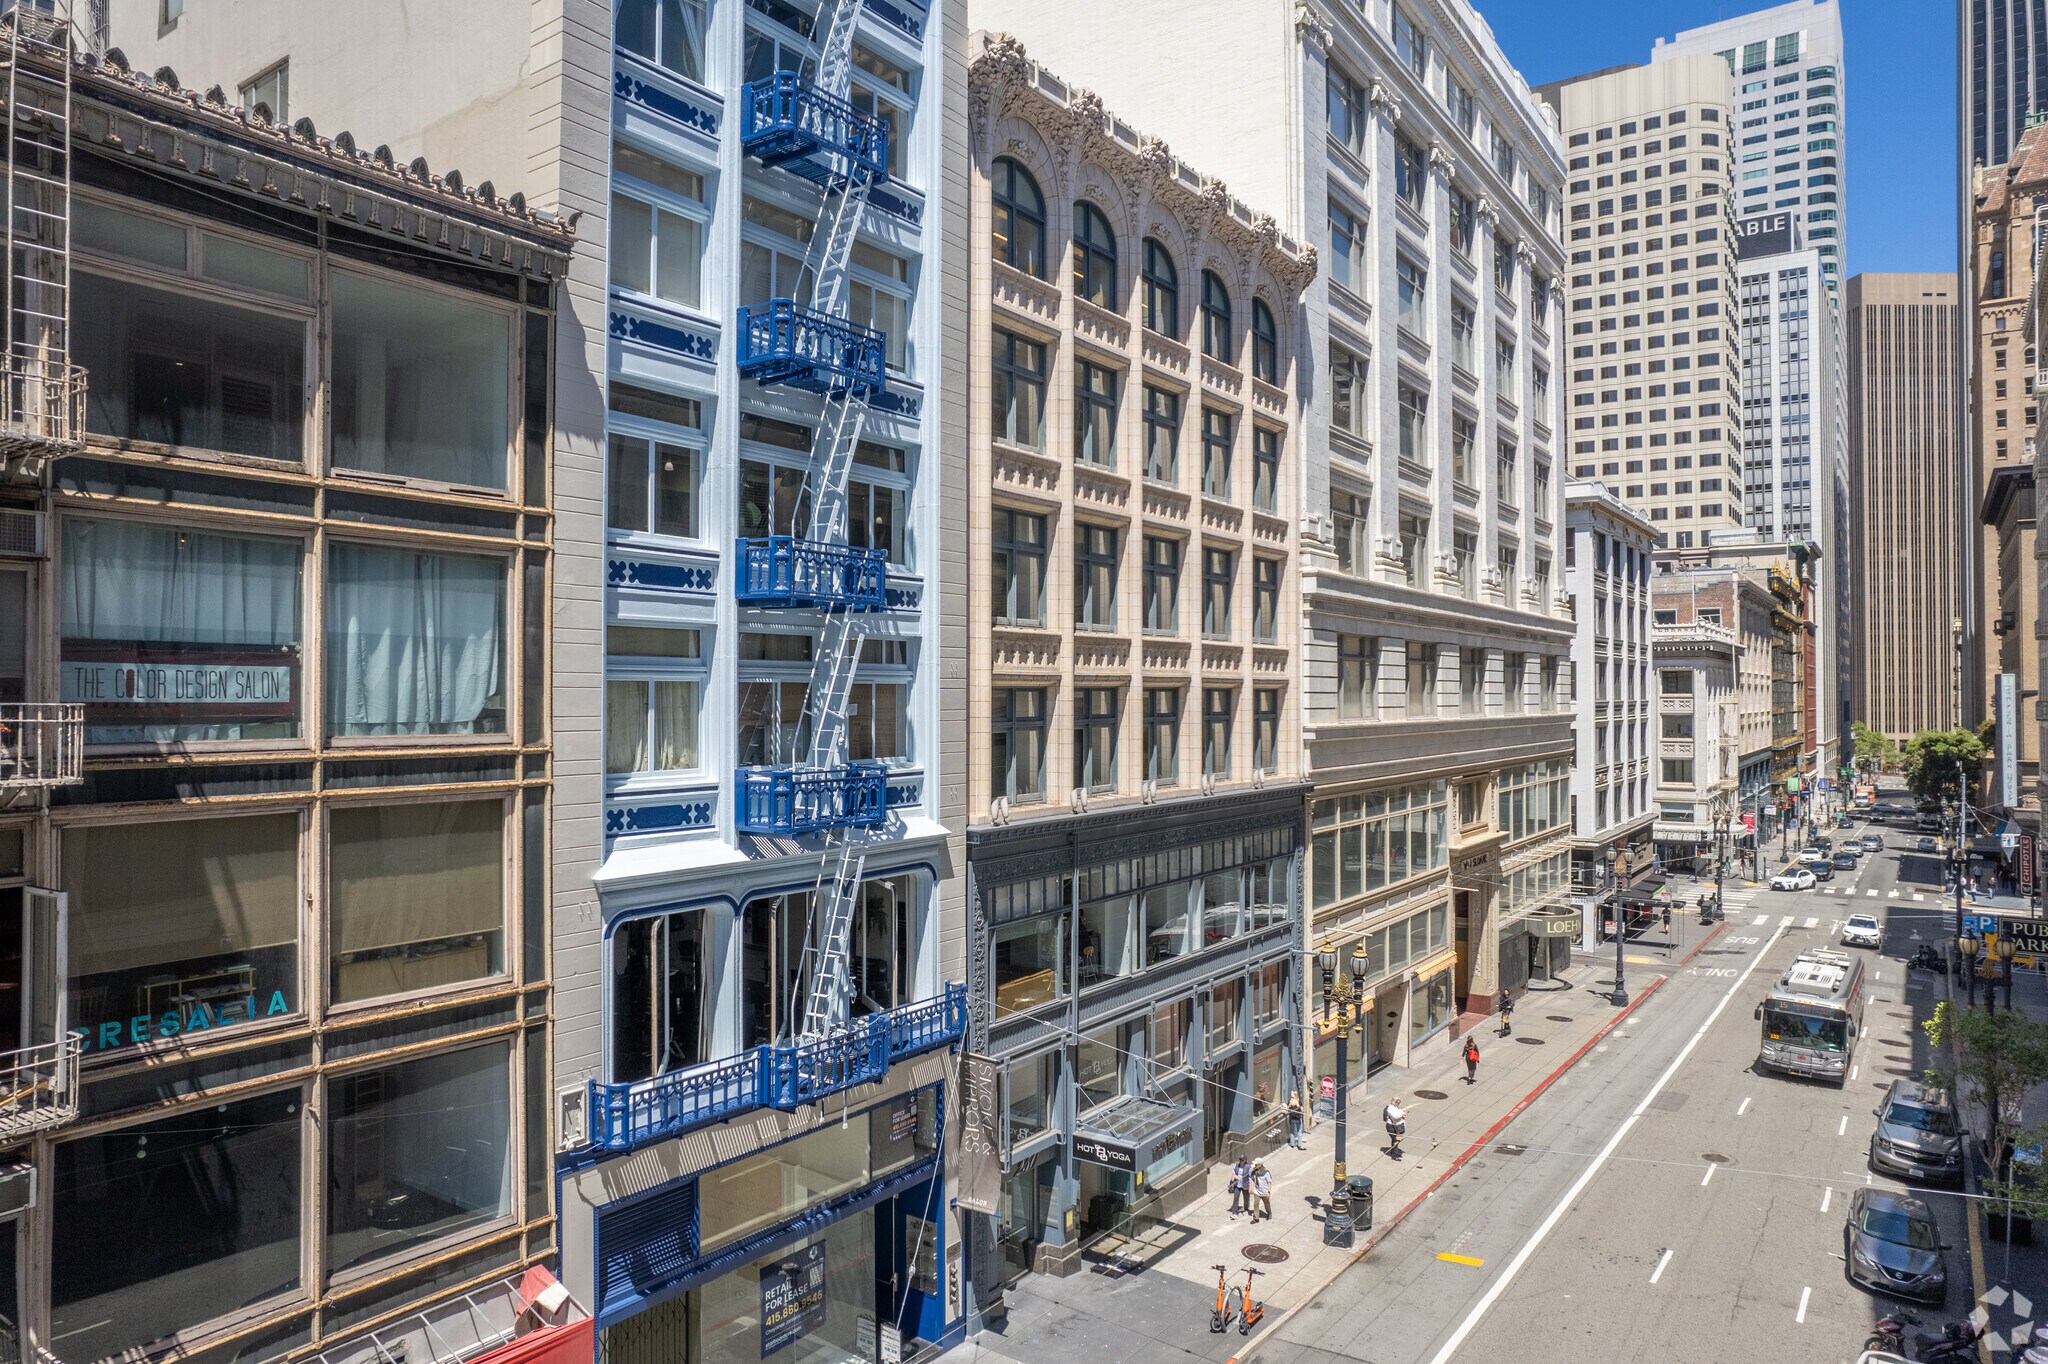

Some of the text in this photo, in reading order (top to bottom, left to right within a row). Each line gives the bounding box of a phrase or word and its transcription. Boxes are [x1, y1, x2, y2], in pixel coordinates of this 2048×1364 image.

[74, 667, 104, 699] THE
[175, 669, 227, 700] DESIGN
[236, 670, 280, 700] SALON
[2022, 838, 2030, 882] CHIPOTLE
[1547, 919, 1579, 933] LOEH
[1980, 916, 1992, 930] P
[1724, 936, 1760, 945] BUS
[1684, 967, 1739, 978] ONLY
[67, 990, 288, 1051] CRESALIA
[964, 1060, 980, 1154] MIRRORS
[978, 1063, 994, 1138] SMOKE
[1076, 1143, 1095, 1154] HOT
[1106, 1150, 1131, 1163] YOGA
[967, 1196, 988, 1206] SALON
[765, 1280, 793, 1302] RETAIL
[765, 1283, 809, 1313] FOR LEASE
